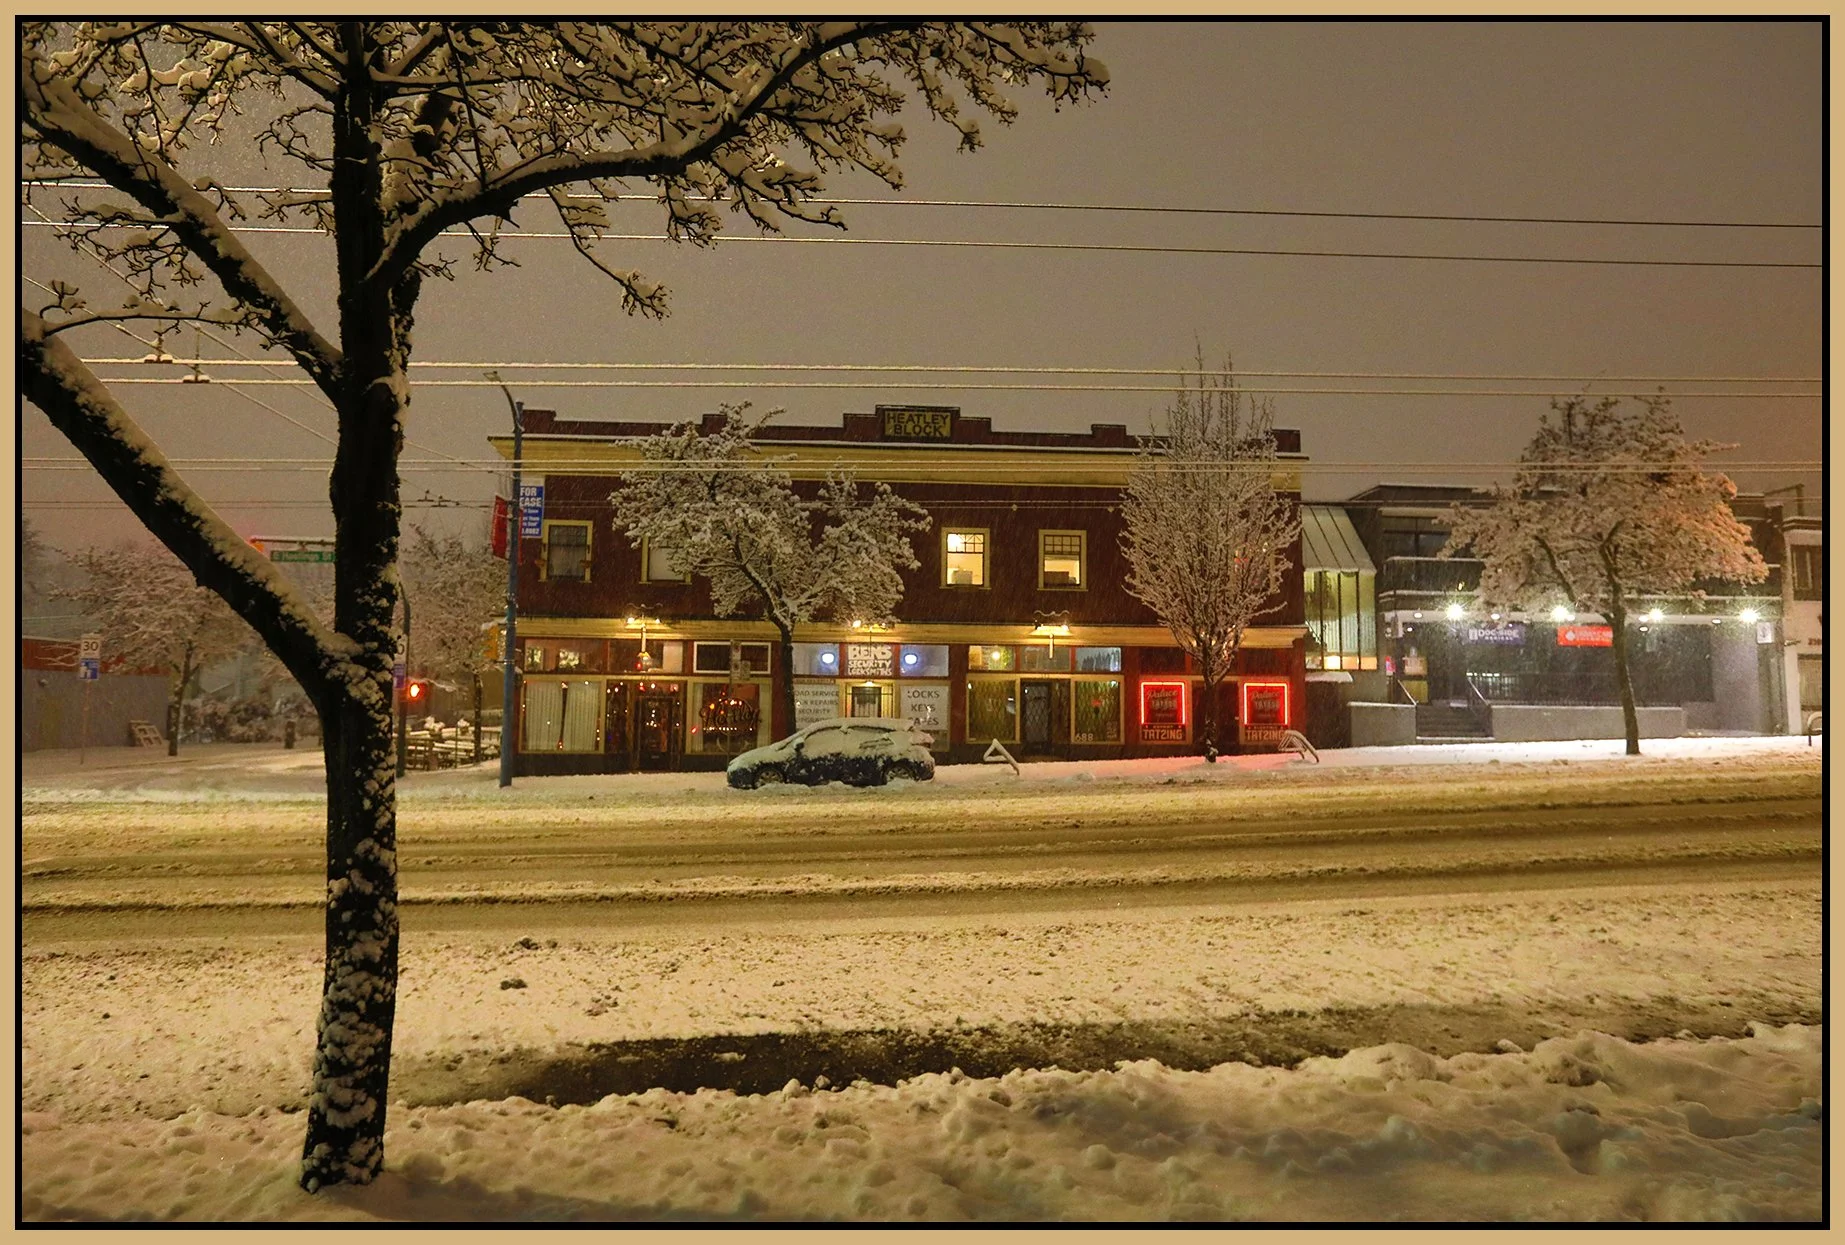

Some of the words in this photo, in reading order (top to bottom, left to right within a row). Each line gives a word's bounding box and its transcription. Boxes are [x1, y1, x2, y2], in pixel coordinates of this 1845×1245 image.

[886, 412, 949, 425] HEATLEY
[894, 424, 944, 437] BLOCK
[520, 487, 537, 496] FOR
[519, 496, 542, 507] EASE
[83, 641, 99, 651] 30
[848, 660, 892, 669] SECURITY
[848, 668, 892, 676] LOCKSMITHS
[907, 690, 940, 698] LOCKS
[911, 704, 936, 712] KEYS
[1076, 733, 1094, 741] 688
